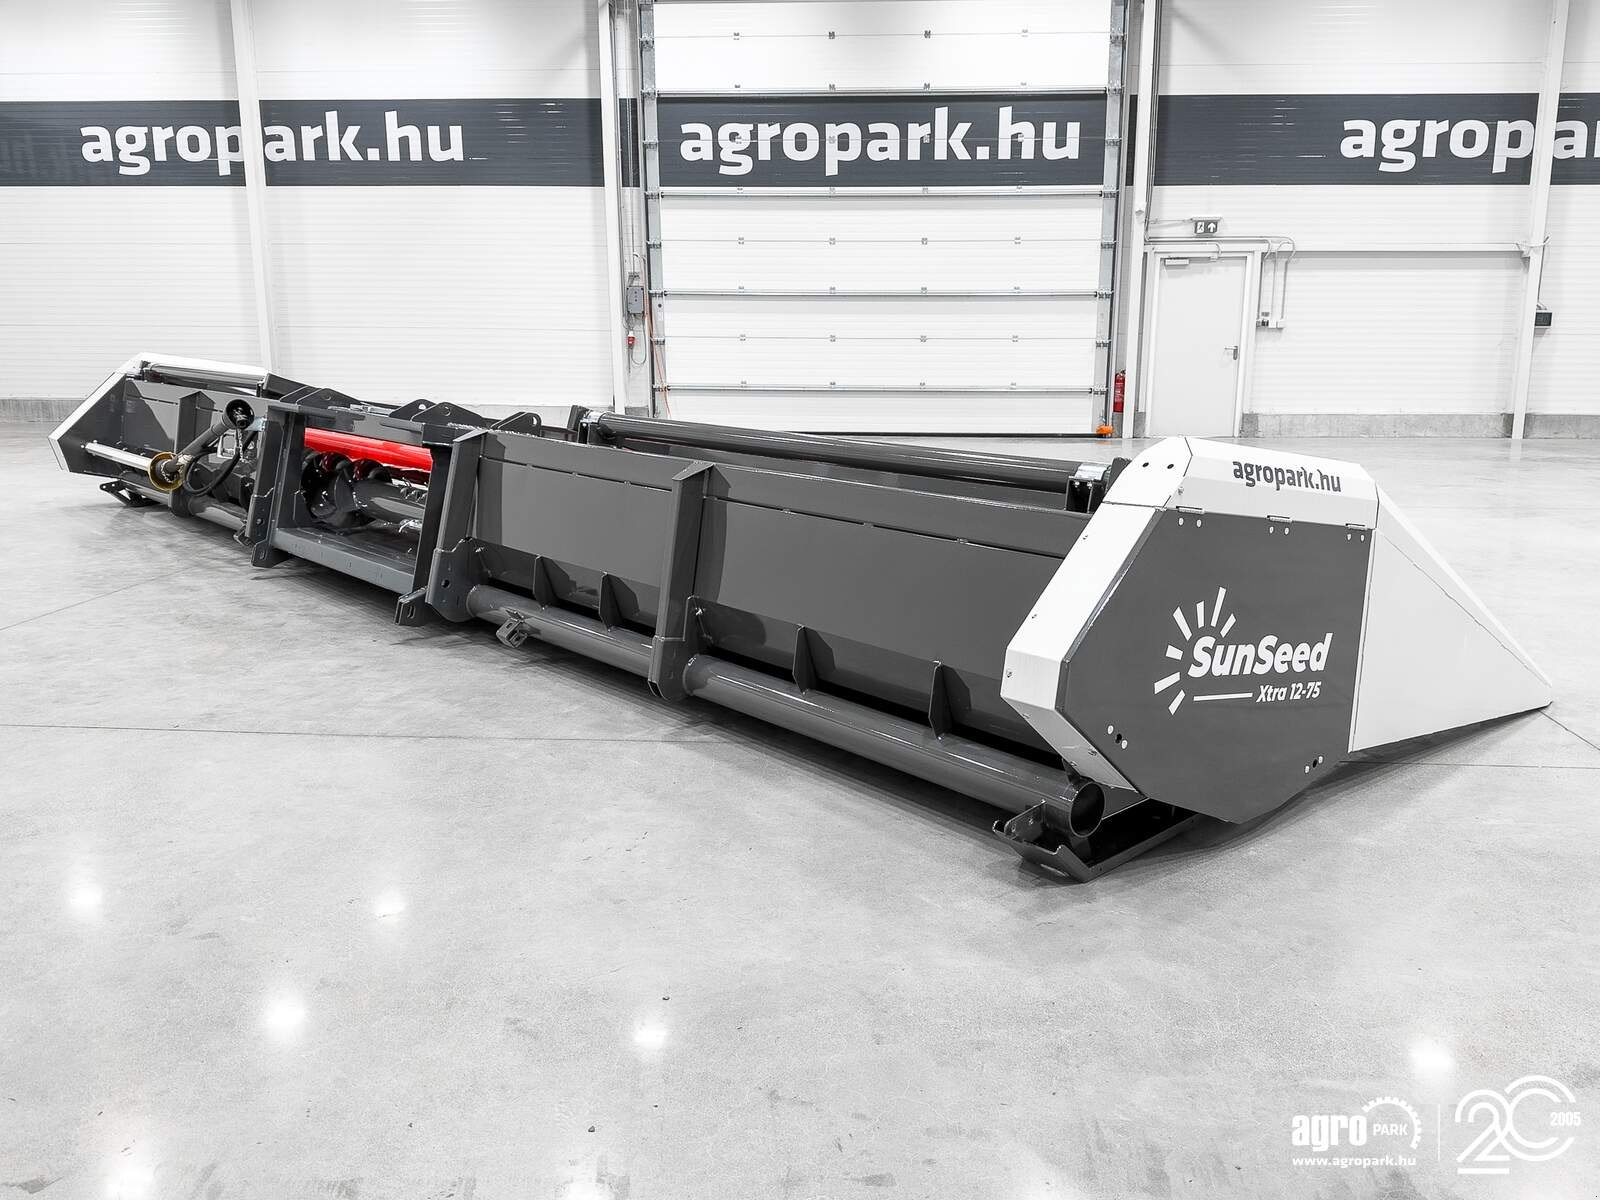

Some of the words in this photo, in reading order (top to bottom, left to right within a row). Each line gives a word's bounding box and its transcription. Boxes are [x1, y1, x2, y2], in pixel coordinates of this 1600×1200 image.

[79, 110, 464, 176] agropark.hu
[680, 105, 1081, 176] agropark.hu
[1340, 119, 1600, 174] agropa
[1232, 461, 1341, 491] agropark.hu
[1187, 632, 1334, 678] SunSeed
[1256, 685, 1287, 703] Xtra
[1289, 681, 1322, 700] 12-75
